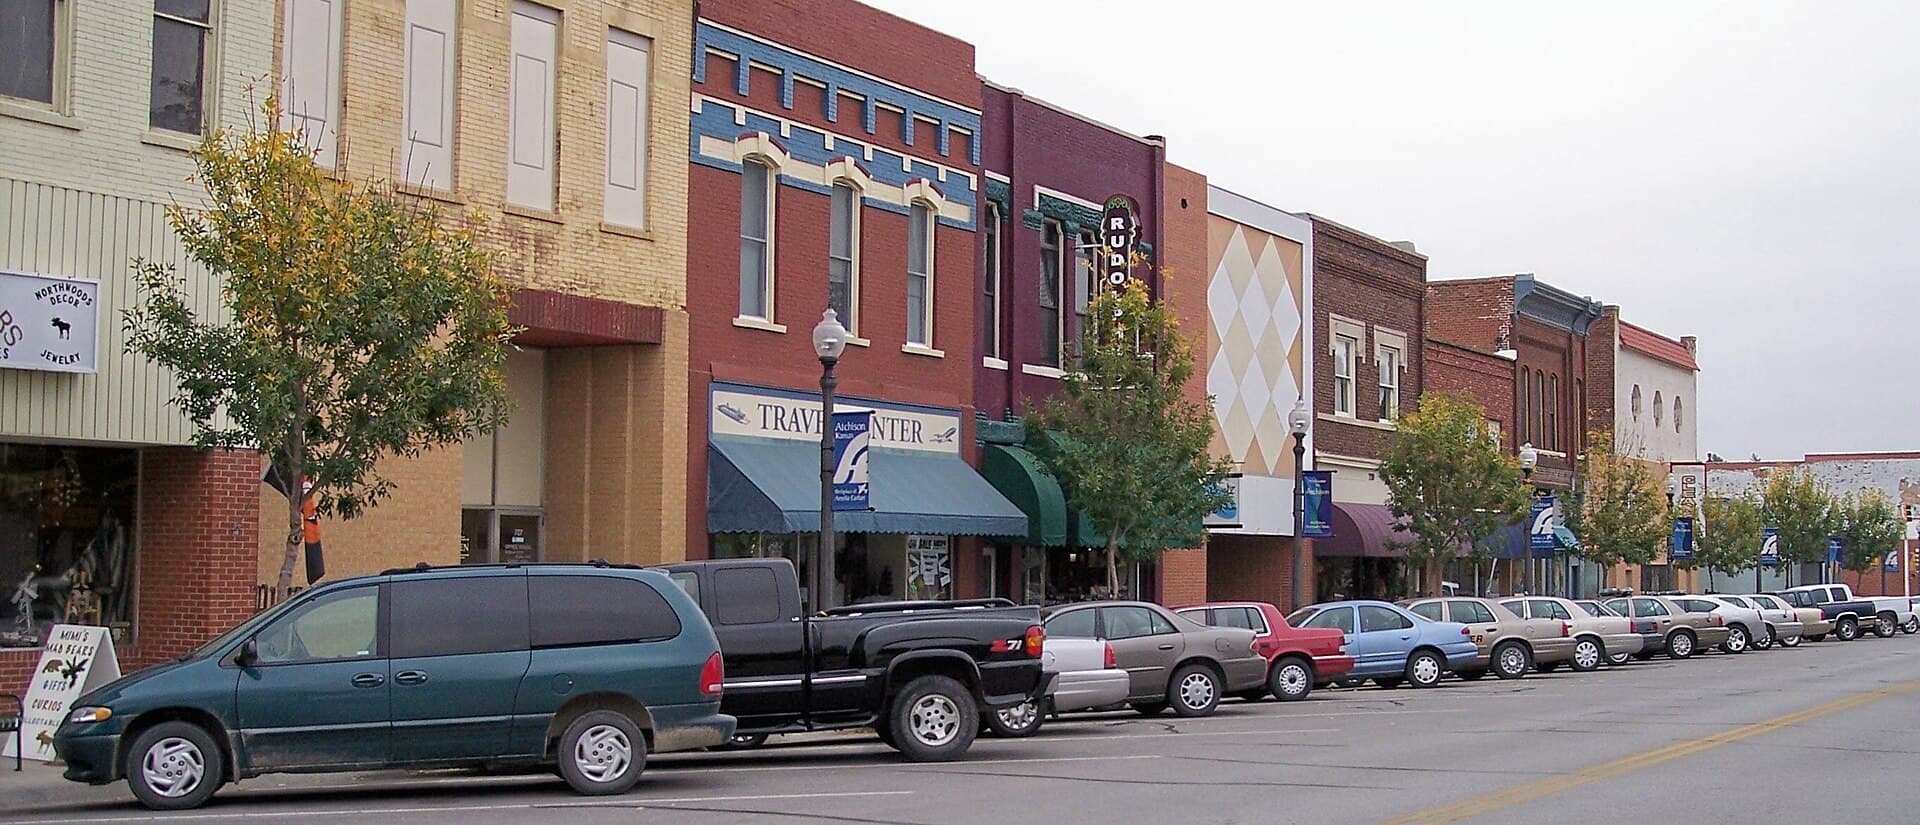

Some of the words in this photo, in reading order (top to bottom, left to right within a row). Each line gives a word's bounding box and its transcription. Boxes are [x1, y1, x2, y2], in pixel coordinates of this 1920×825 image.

[34, 282, 93, 306] NORTHWOODS
[50, 294, 80, 308] DECOR
[40, 349, 80, 365] JEWELRY
[834, 421, 866, 432] Atchison
[872, 416, 923, 443] NTER
[60, 630, 89, 642] MIMI'S
[65, 644, 94, 656] BEARS
[990, 639, 1023, 652] Z71
[43, 680, 67, 692] GIFTS
[31, 699, 63, 712] CURIOS
